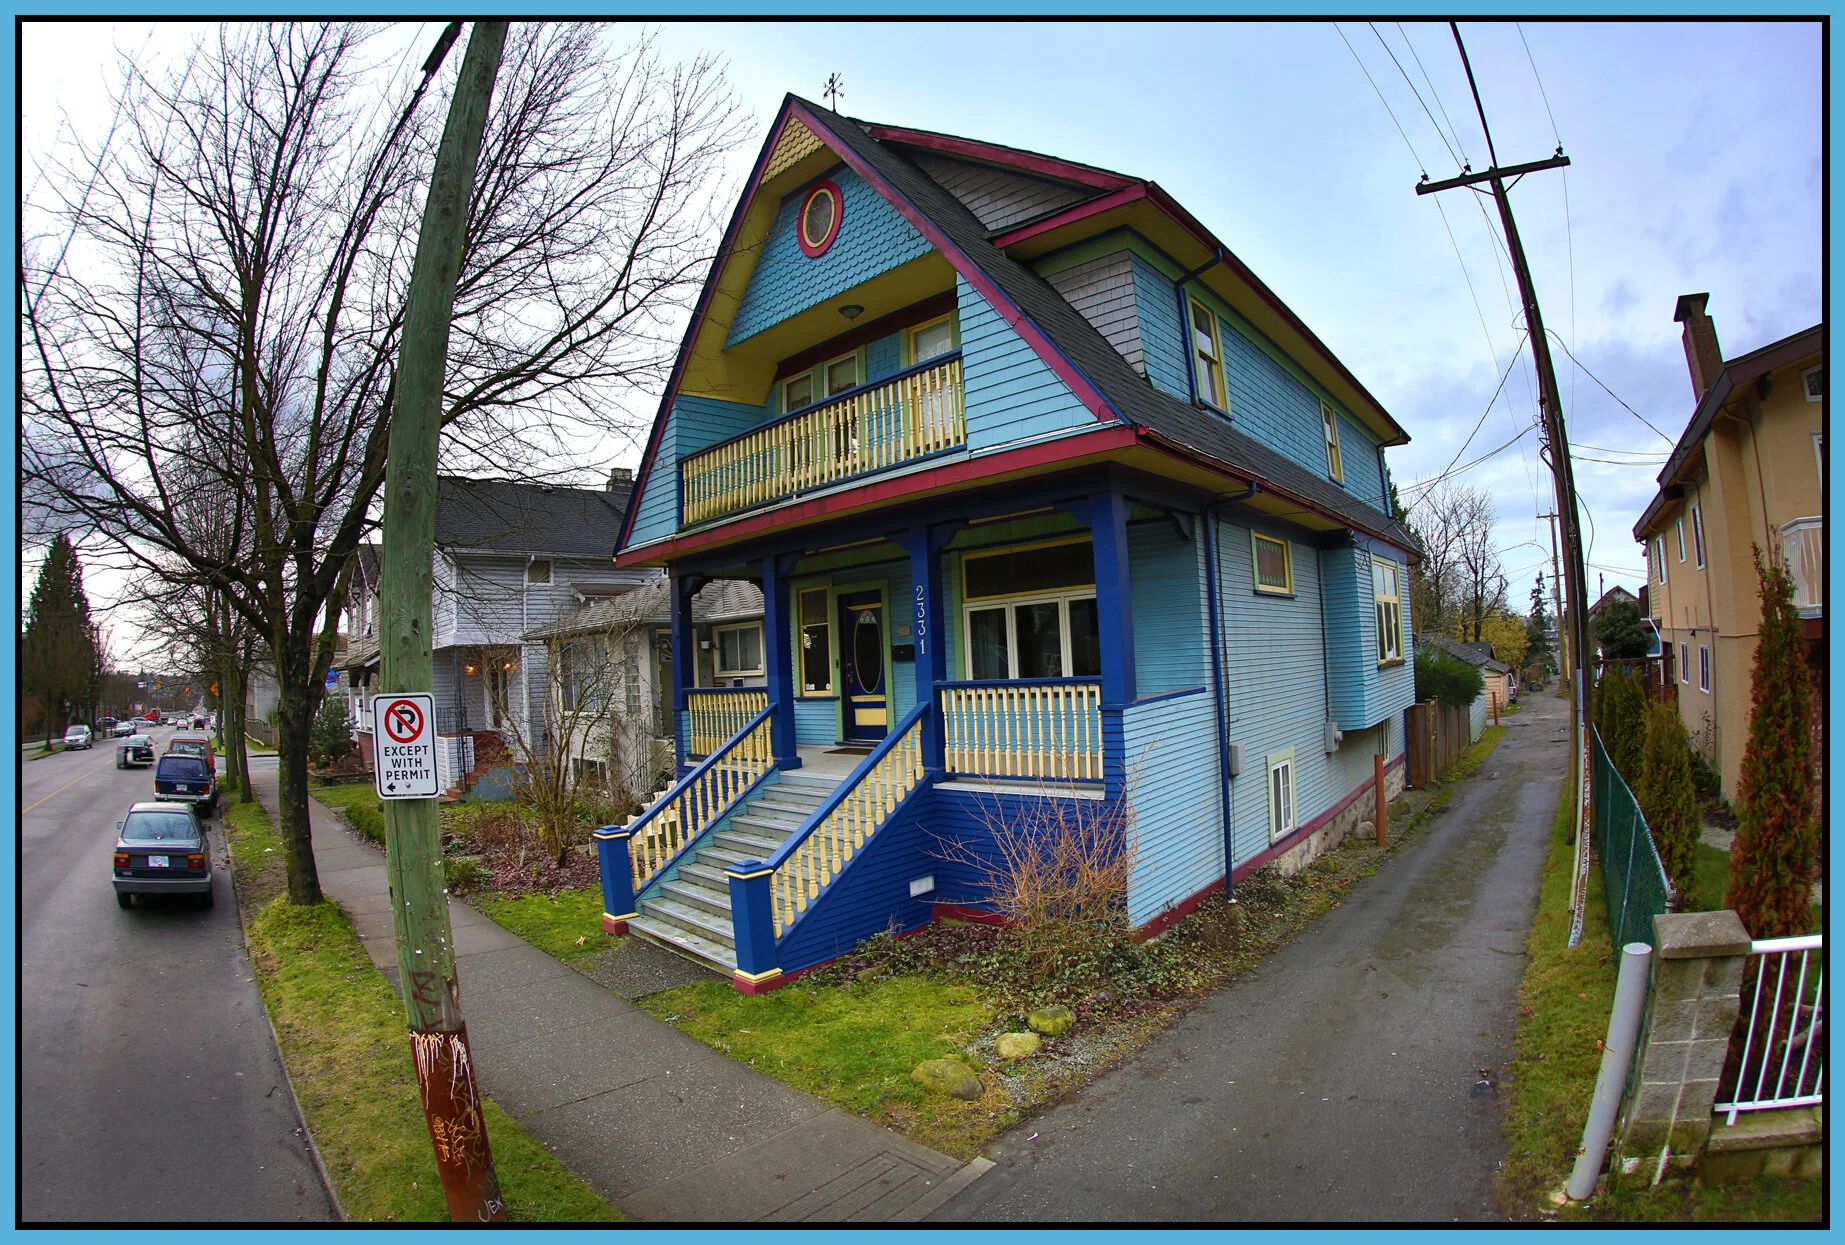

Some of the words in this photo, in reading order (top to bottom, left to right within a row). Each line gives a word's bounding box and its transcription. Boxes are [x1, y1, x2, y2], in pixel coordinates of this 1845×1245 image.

[916, 585, 926, 655] 2331
[384, 745, 428, 757] EXCEPT
[391, 757, 422, 768] WITH
[386, 769, 431, 780] PERMIT
